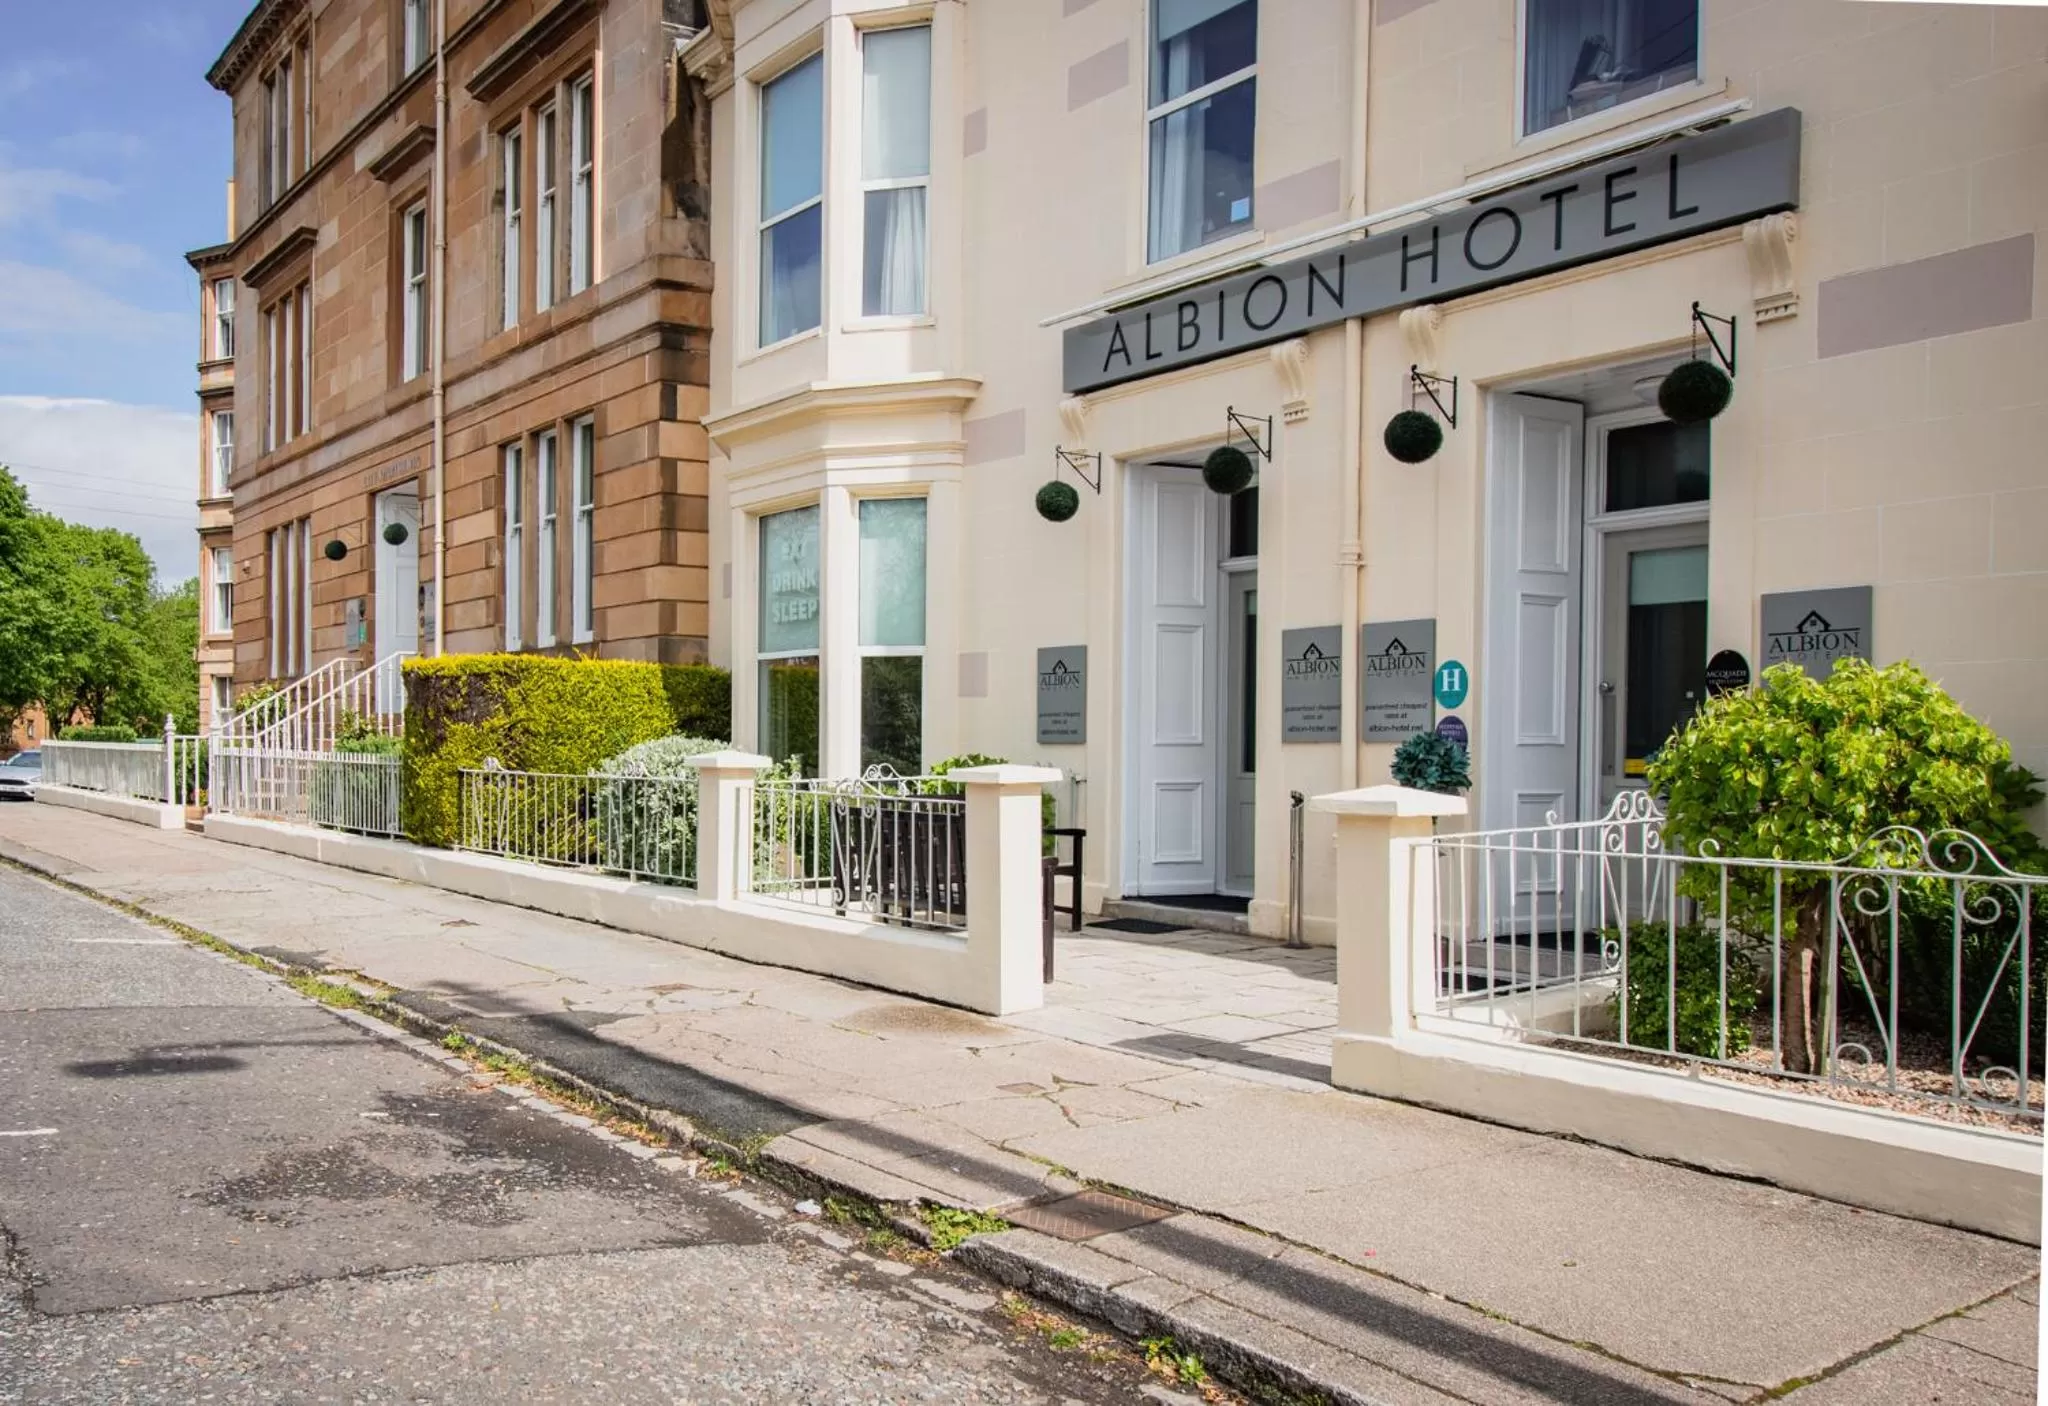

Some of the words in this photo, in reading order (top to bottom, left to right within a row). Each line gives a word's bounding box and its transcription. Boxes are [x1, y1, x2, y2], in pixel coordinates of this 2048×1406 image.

[1103, 255, 1344, 372] ALBION
[1401, 154, 1699, 291] HOTEL
[773, 568, 816, 593] DRINK
[773, 599, 818, 624] SLEEP
[1769, 632, 1860, 653] ALBION
[1287, 660, 1339, 675] ALBION
[1368, 655, 1425, 672] ALBION
[1040, 674, 1079, 686] ALBION
[1441, 668, 1462, 691] H
